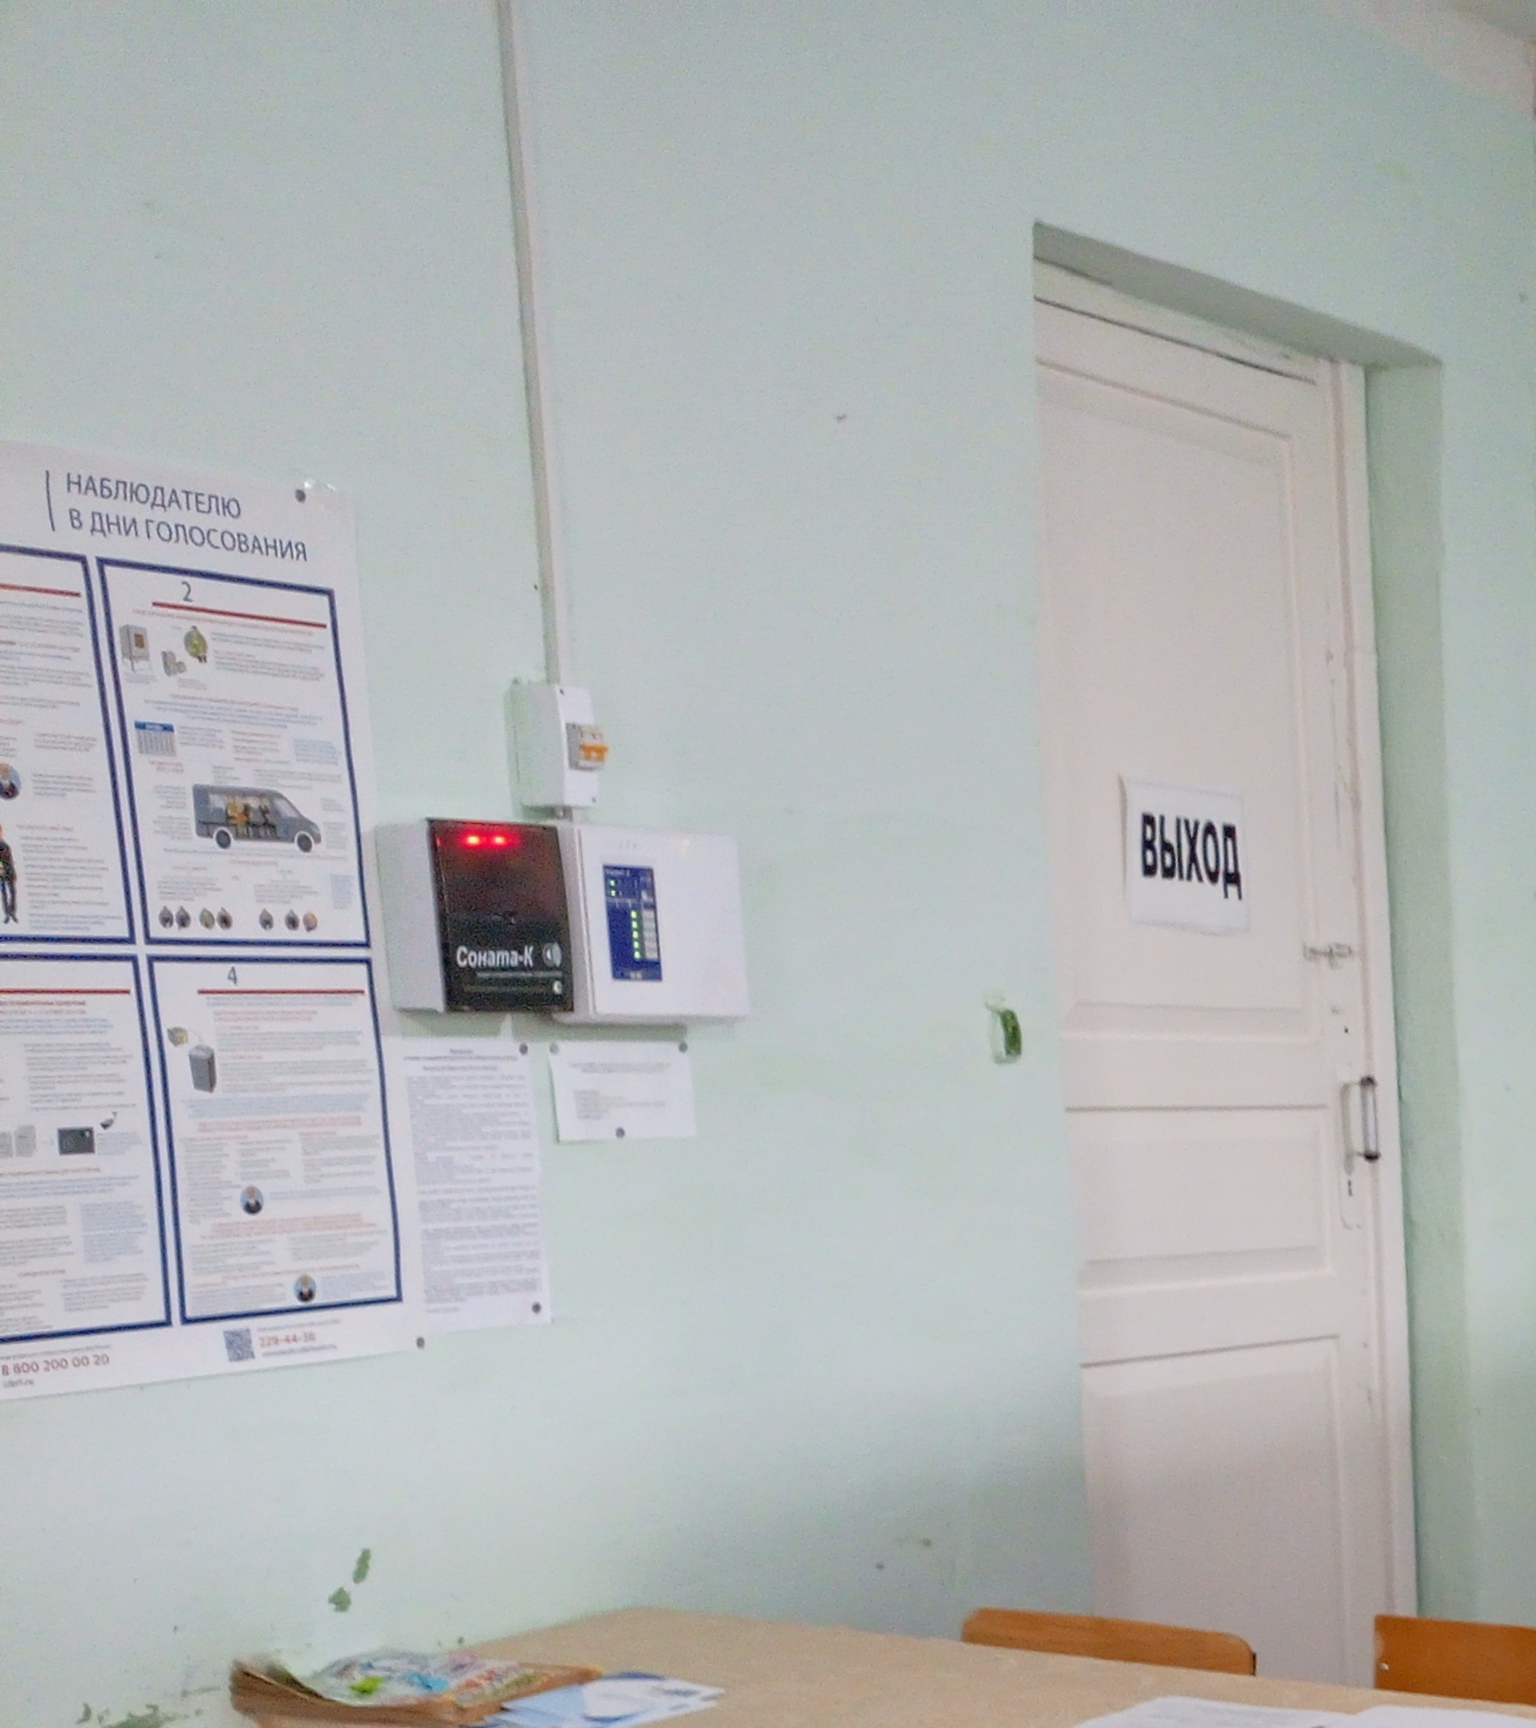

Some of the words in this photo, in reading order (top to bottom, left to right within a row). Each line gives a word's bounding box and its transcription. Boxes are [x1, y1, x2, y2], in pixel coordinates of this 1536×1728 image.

[66, 472, 241, 519] НАБЛЮДАТЕЛЮ
[68, 508, 83, 530] В
[89, 511, 139, 539] ДНИ
[145, 518, 308, 562] ГОЛОСОВАНИЯ
[181, 581, 194, 602] 2
[1141, 812, 1242, 900] ВЫХОД
[227, 965, 238, 985] 4
[43, 1358, 68, 1372] 200
[71, 1355, 90, 1368] 00
